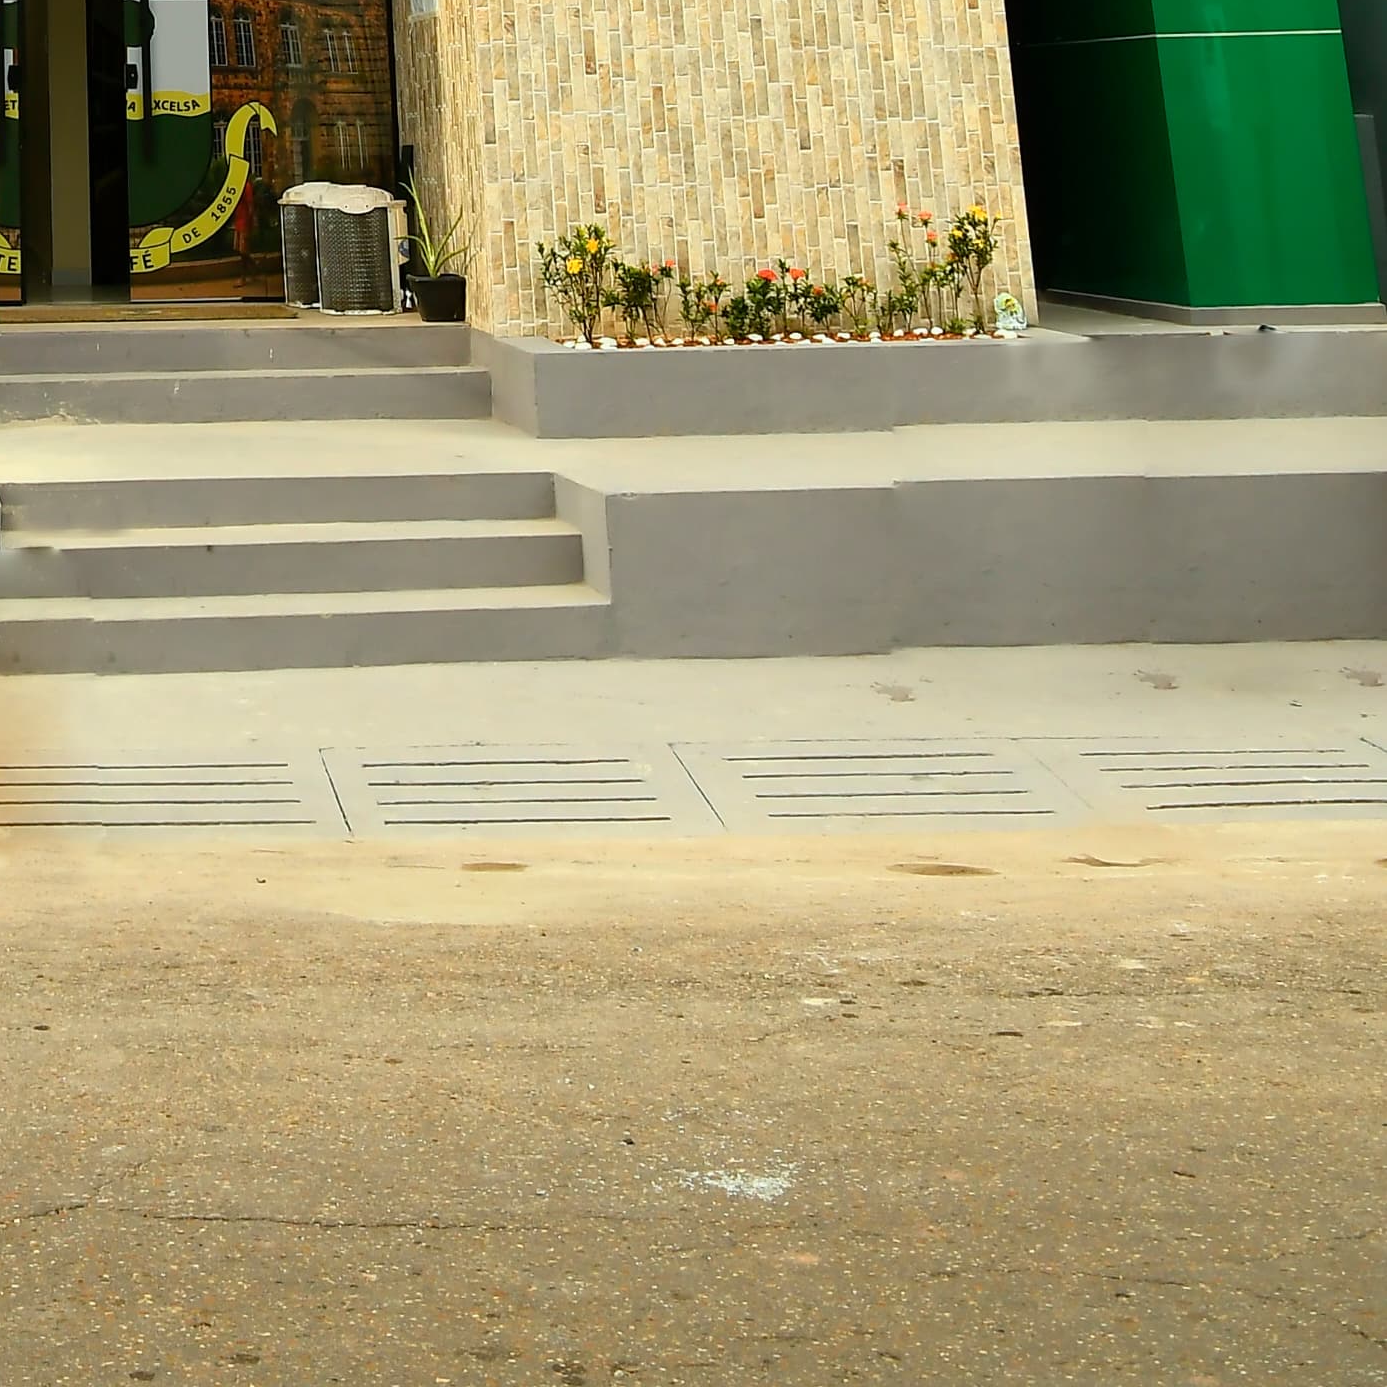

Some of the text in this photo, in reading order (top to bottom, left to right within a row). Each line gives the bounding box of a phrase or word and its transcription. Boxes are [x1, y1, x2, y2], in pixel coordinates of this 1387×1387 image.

[151, 99, 201, 112] XCELSA
[182, 186, 237, 244] DE 1855
